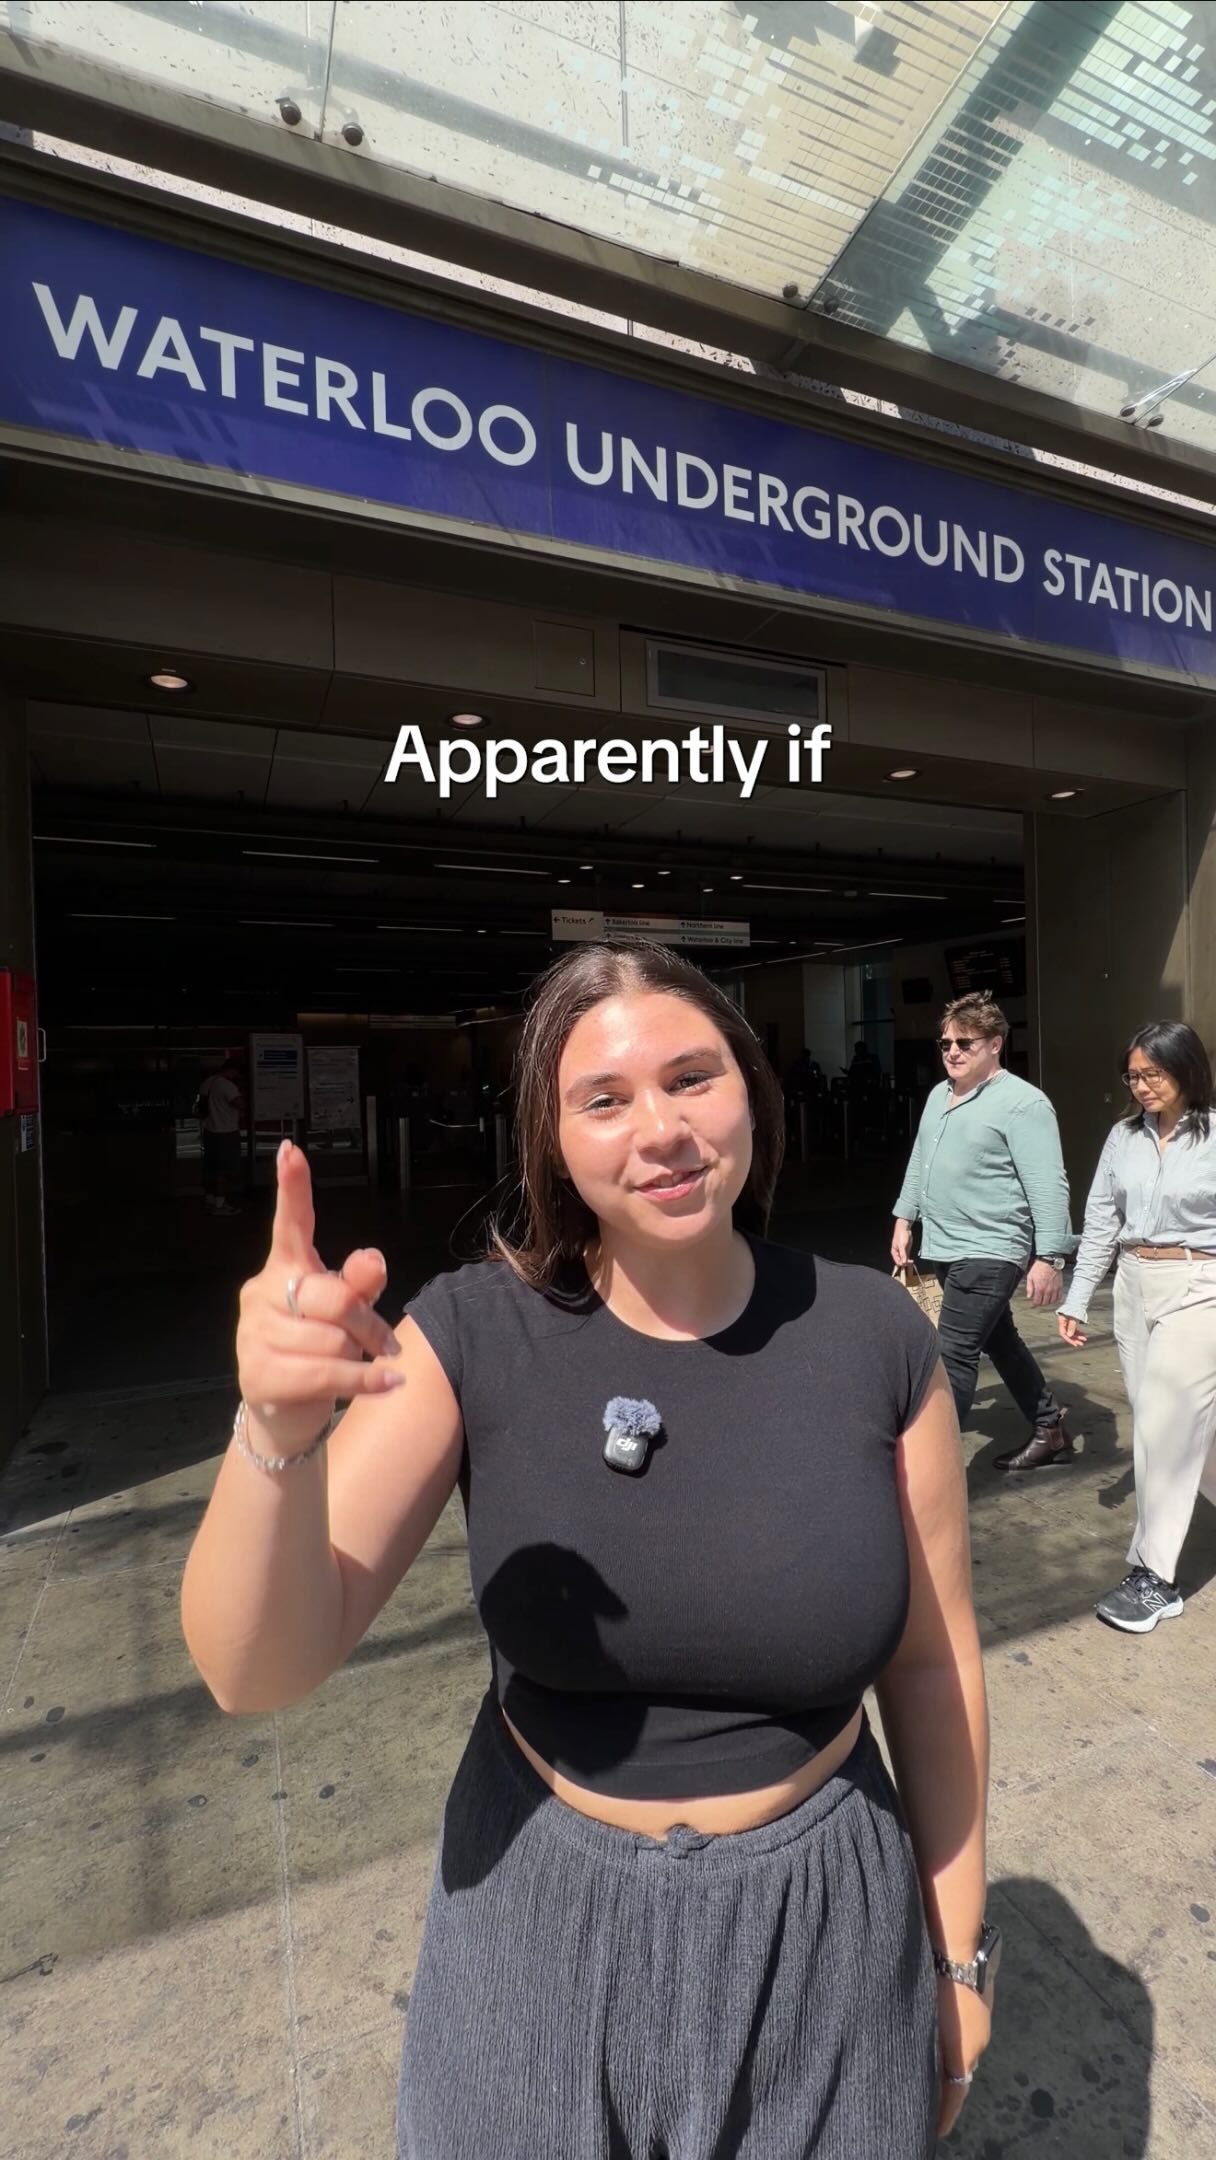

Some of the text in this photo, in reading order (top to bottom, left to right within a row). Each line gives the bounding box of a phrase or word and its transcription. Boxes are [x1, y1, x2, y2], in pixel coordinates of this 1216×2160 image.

[32, 282, 1212, 632] WATERLOO UNDERGROUND STATION
[562, 917, 587, 925] Tickets
[720, 937, 732, 945] City
